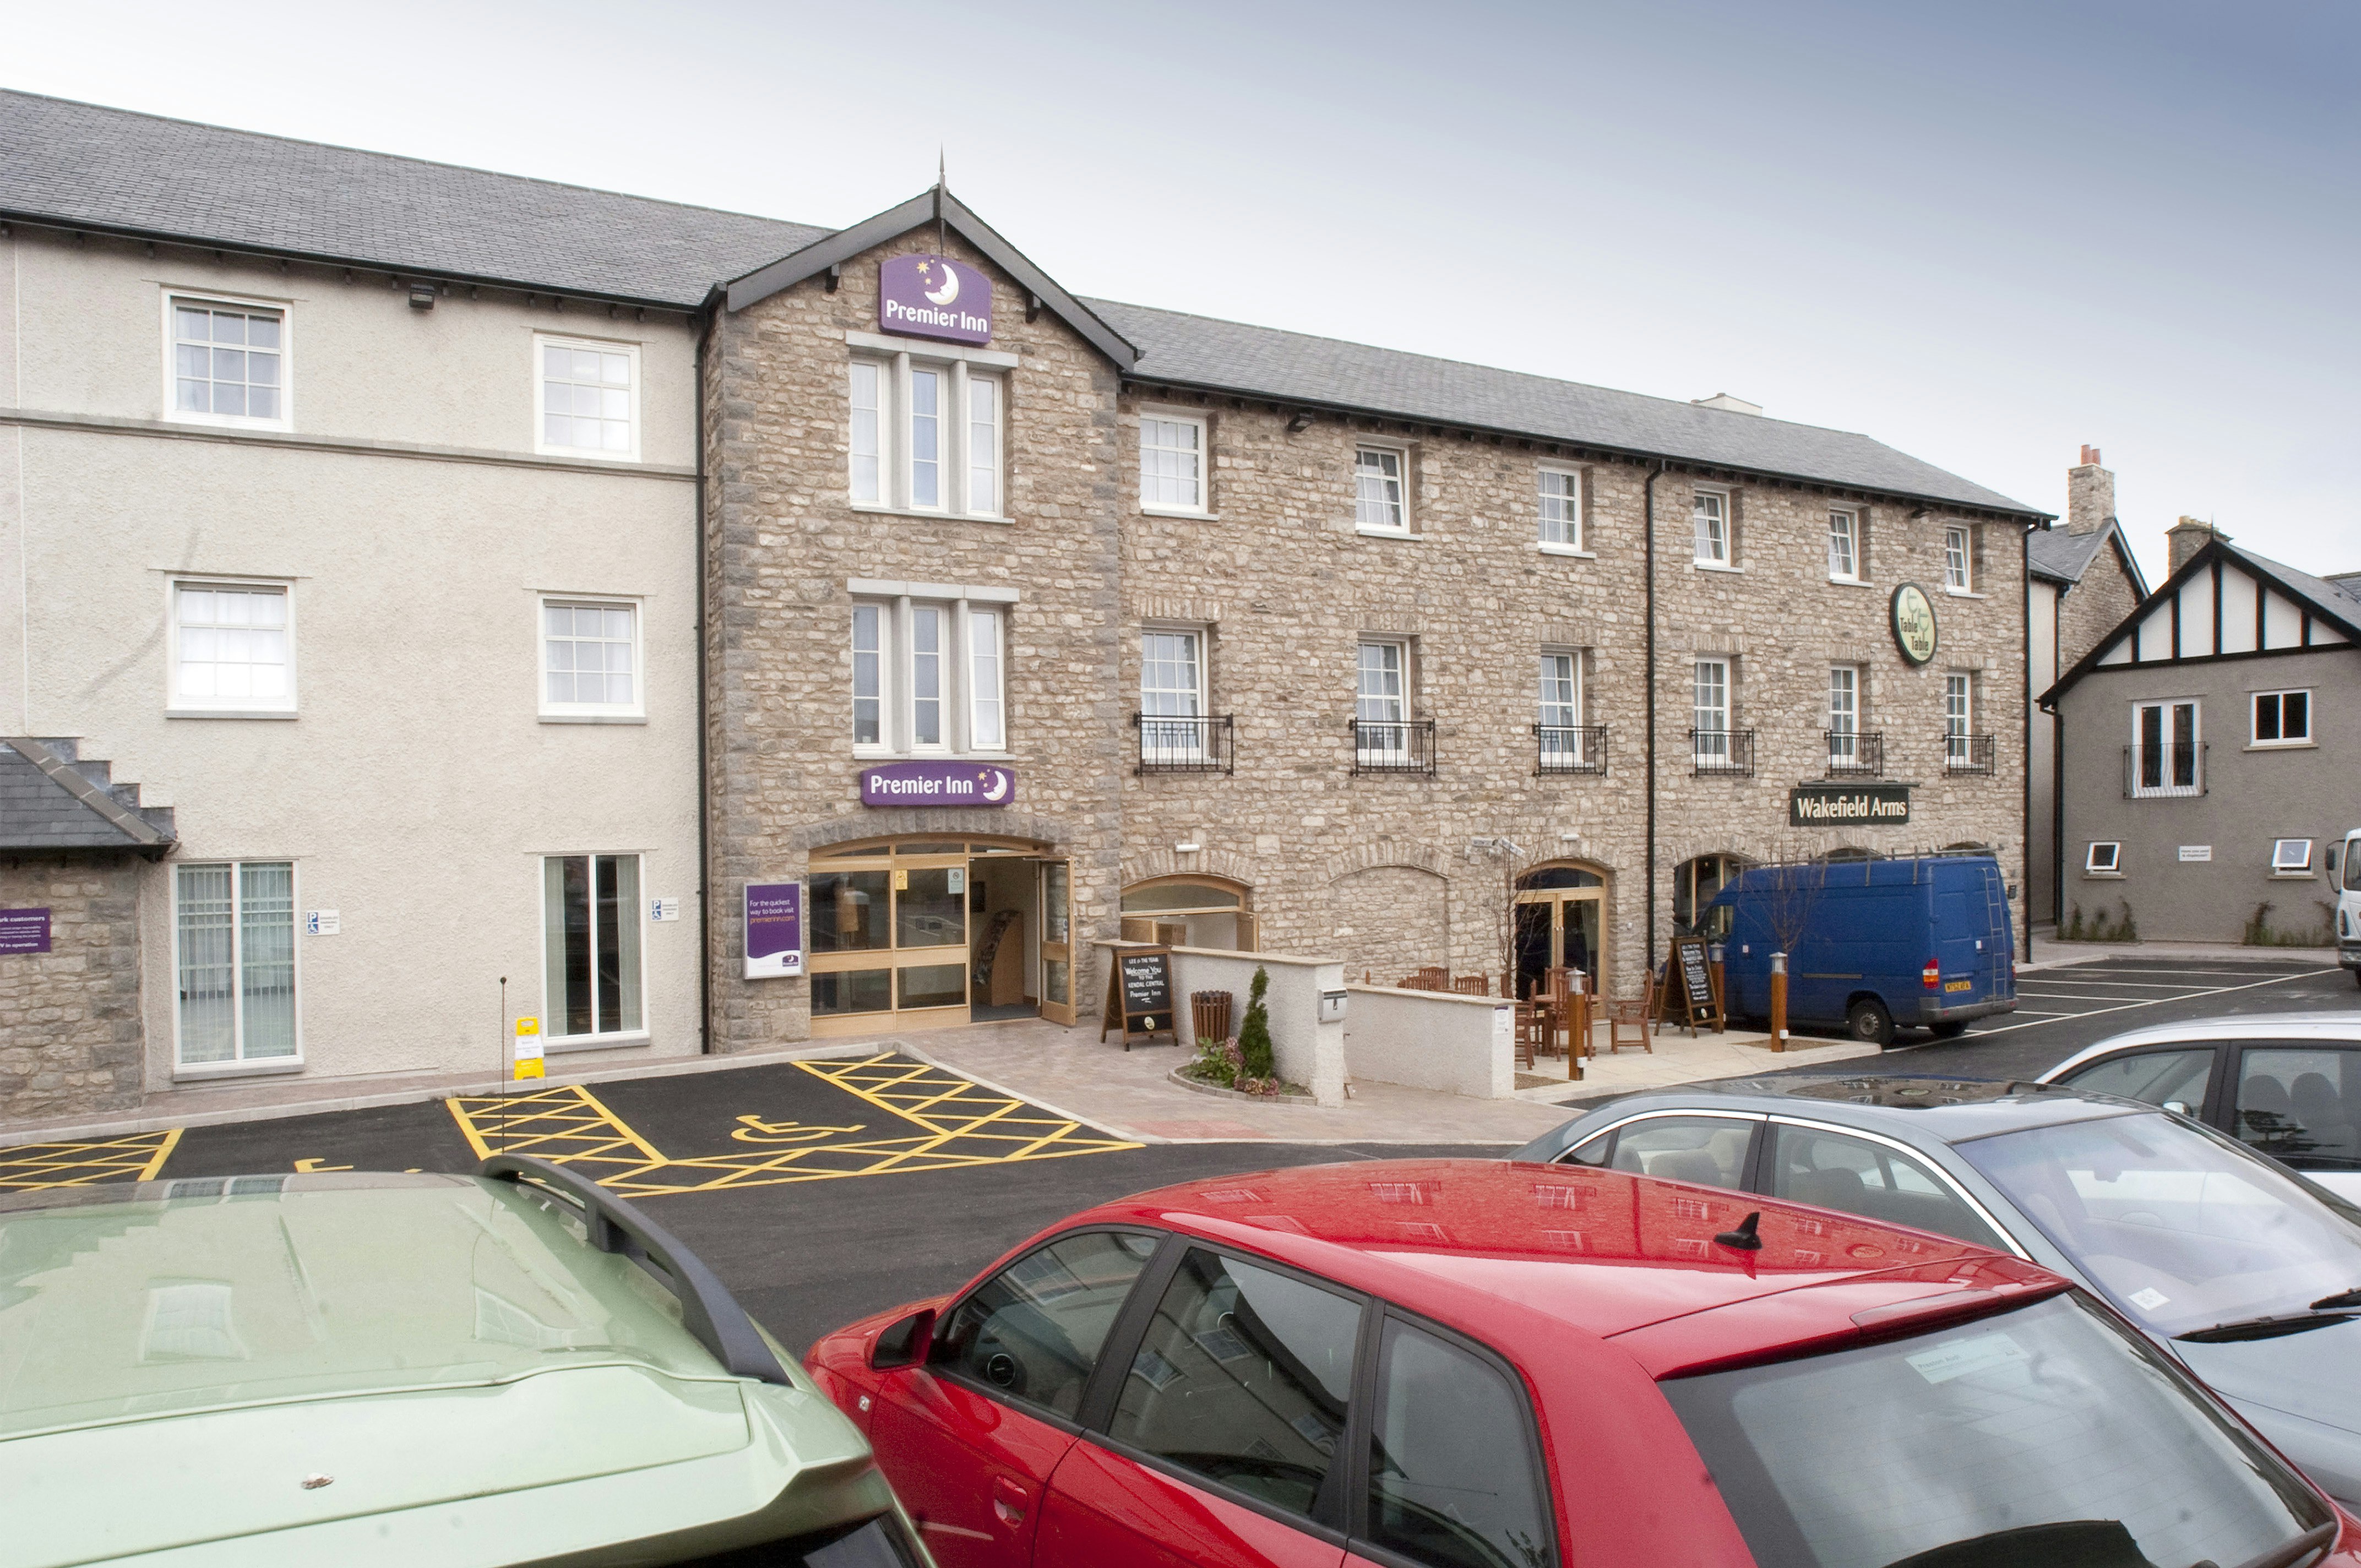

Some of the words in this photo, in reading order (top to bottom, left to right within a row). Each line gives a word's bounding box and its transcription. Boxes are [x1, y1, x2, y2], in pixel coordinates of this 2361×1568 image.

[886, 299, 958, 328] Premier
[961, 311, 988, 333] Inn
[1900, 616, 1918, 633] Table
[1911, 635, 1929, 651] Table
[871, 775, 943, 794] Premier
[946, 776, 973, 794] Inn
[1797, 796, 1869, 818] Wakefield
[1871, 797, 1907, 816] Arms
[654, 901, 660, 909] P
[309, 912, 317, 922] P
